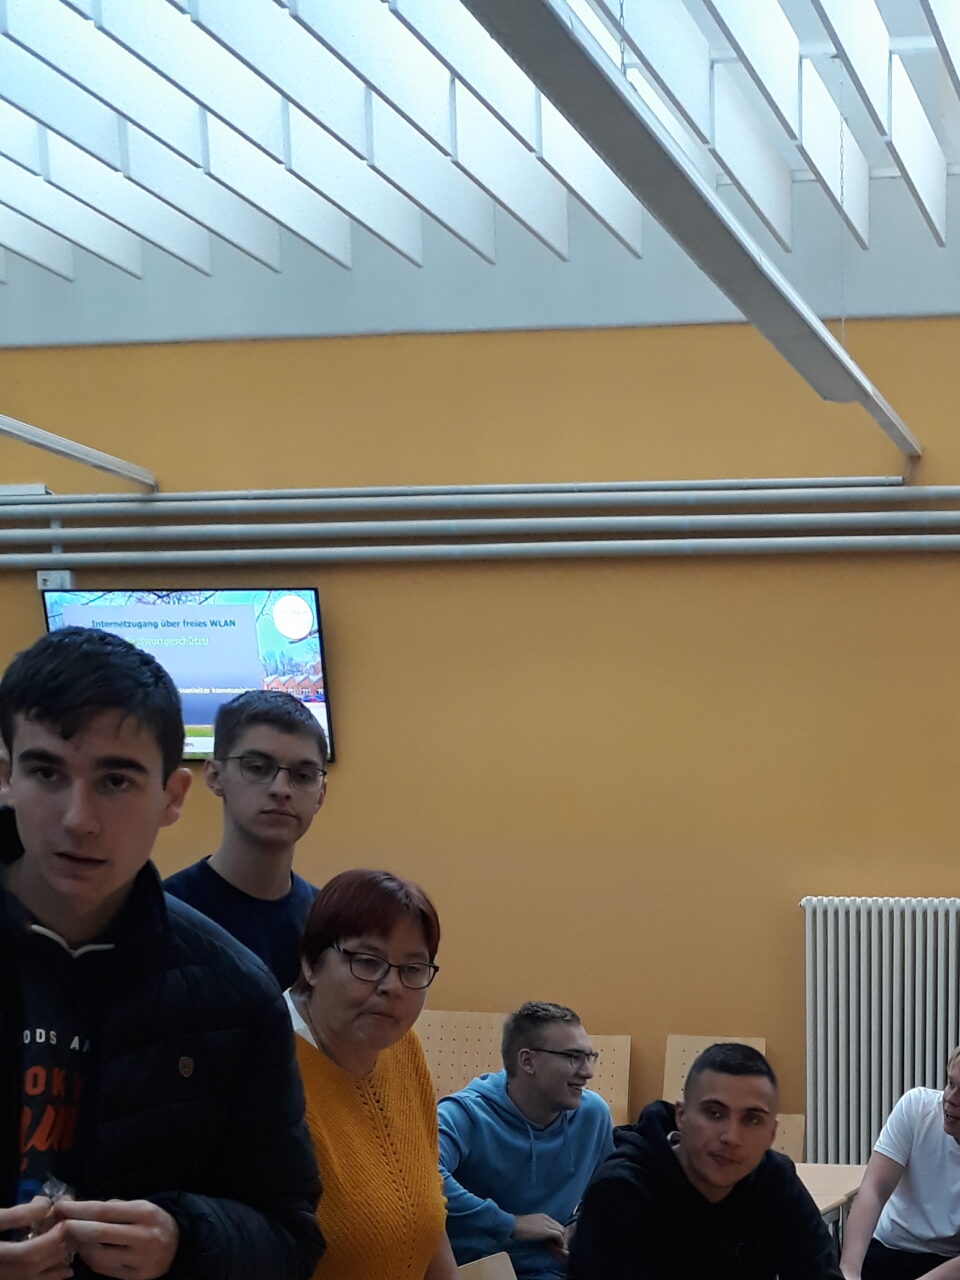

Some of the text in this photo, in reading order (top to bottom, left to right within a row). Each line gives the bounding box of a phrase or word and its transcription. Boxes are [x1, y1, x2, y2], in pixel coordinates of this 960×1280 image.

[91, 619, 236, 629] Internetzugang über freies WLAN
